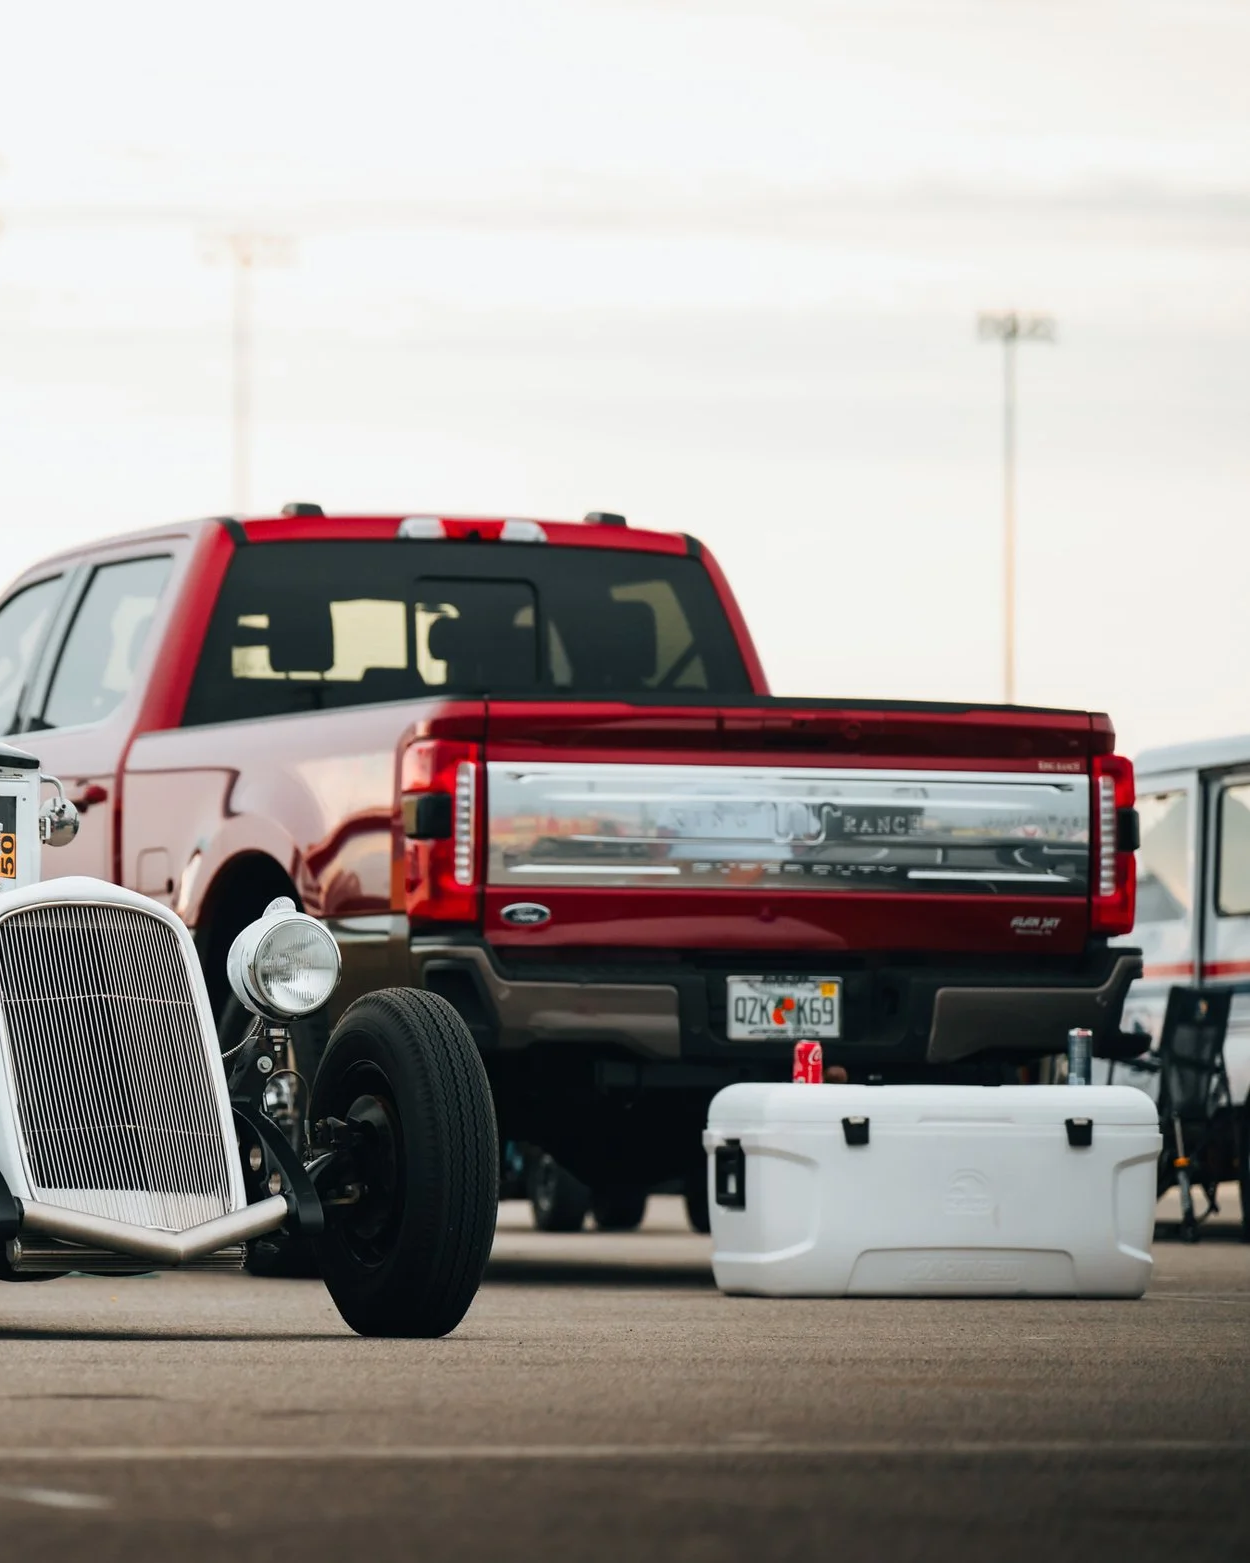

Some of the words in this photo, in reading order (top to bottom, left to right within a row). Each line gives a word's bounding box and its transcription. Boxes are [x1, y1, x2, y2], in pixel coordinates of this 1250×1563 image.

[842, 813, 924, 836] RANCH
[1, 835, 14, 875] 50
[734, 996, 771, 1026] QZK
[797, 996, 835, 1026] K69
